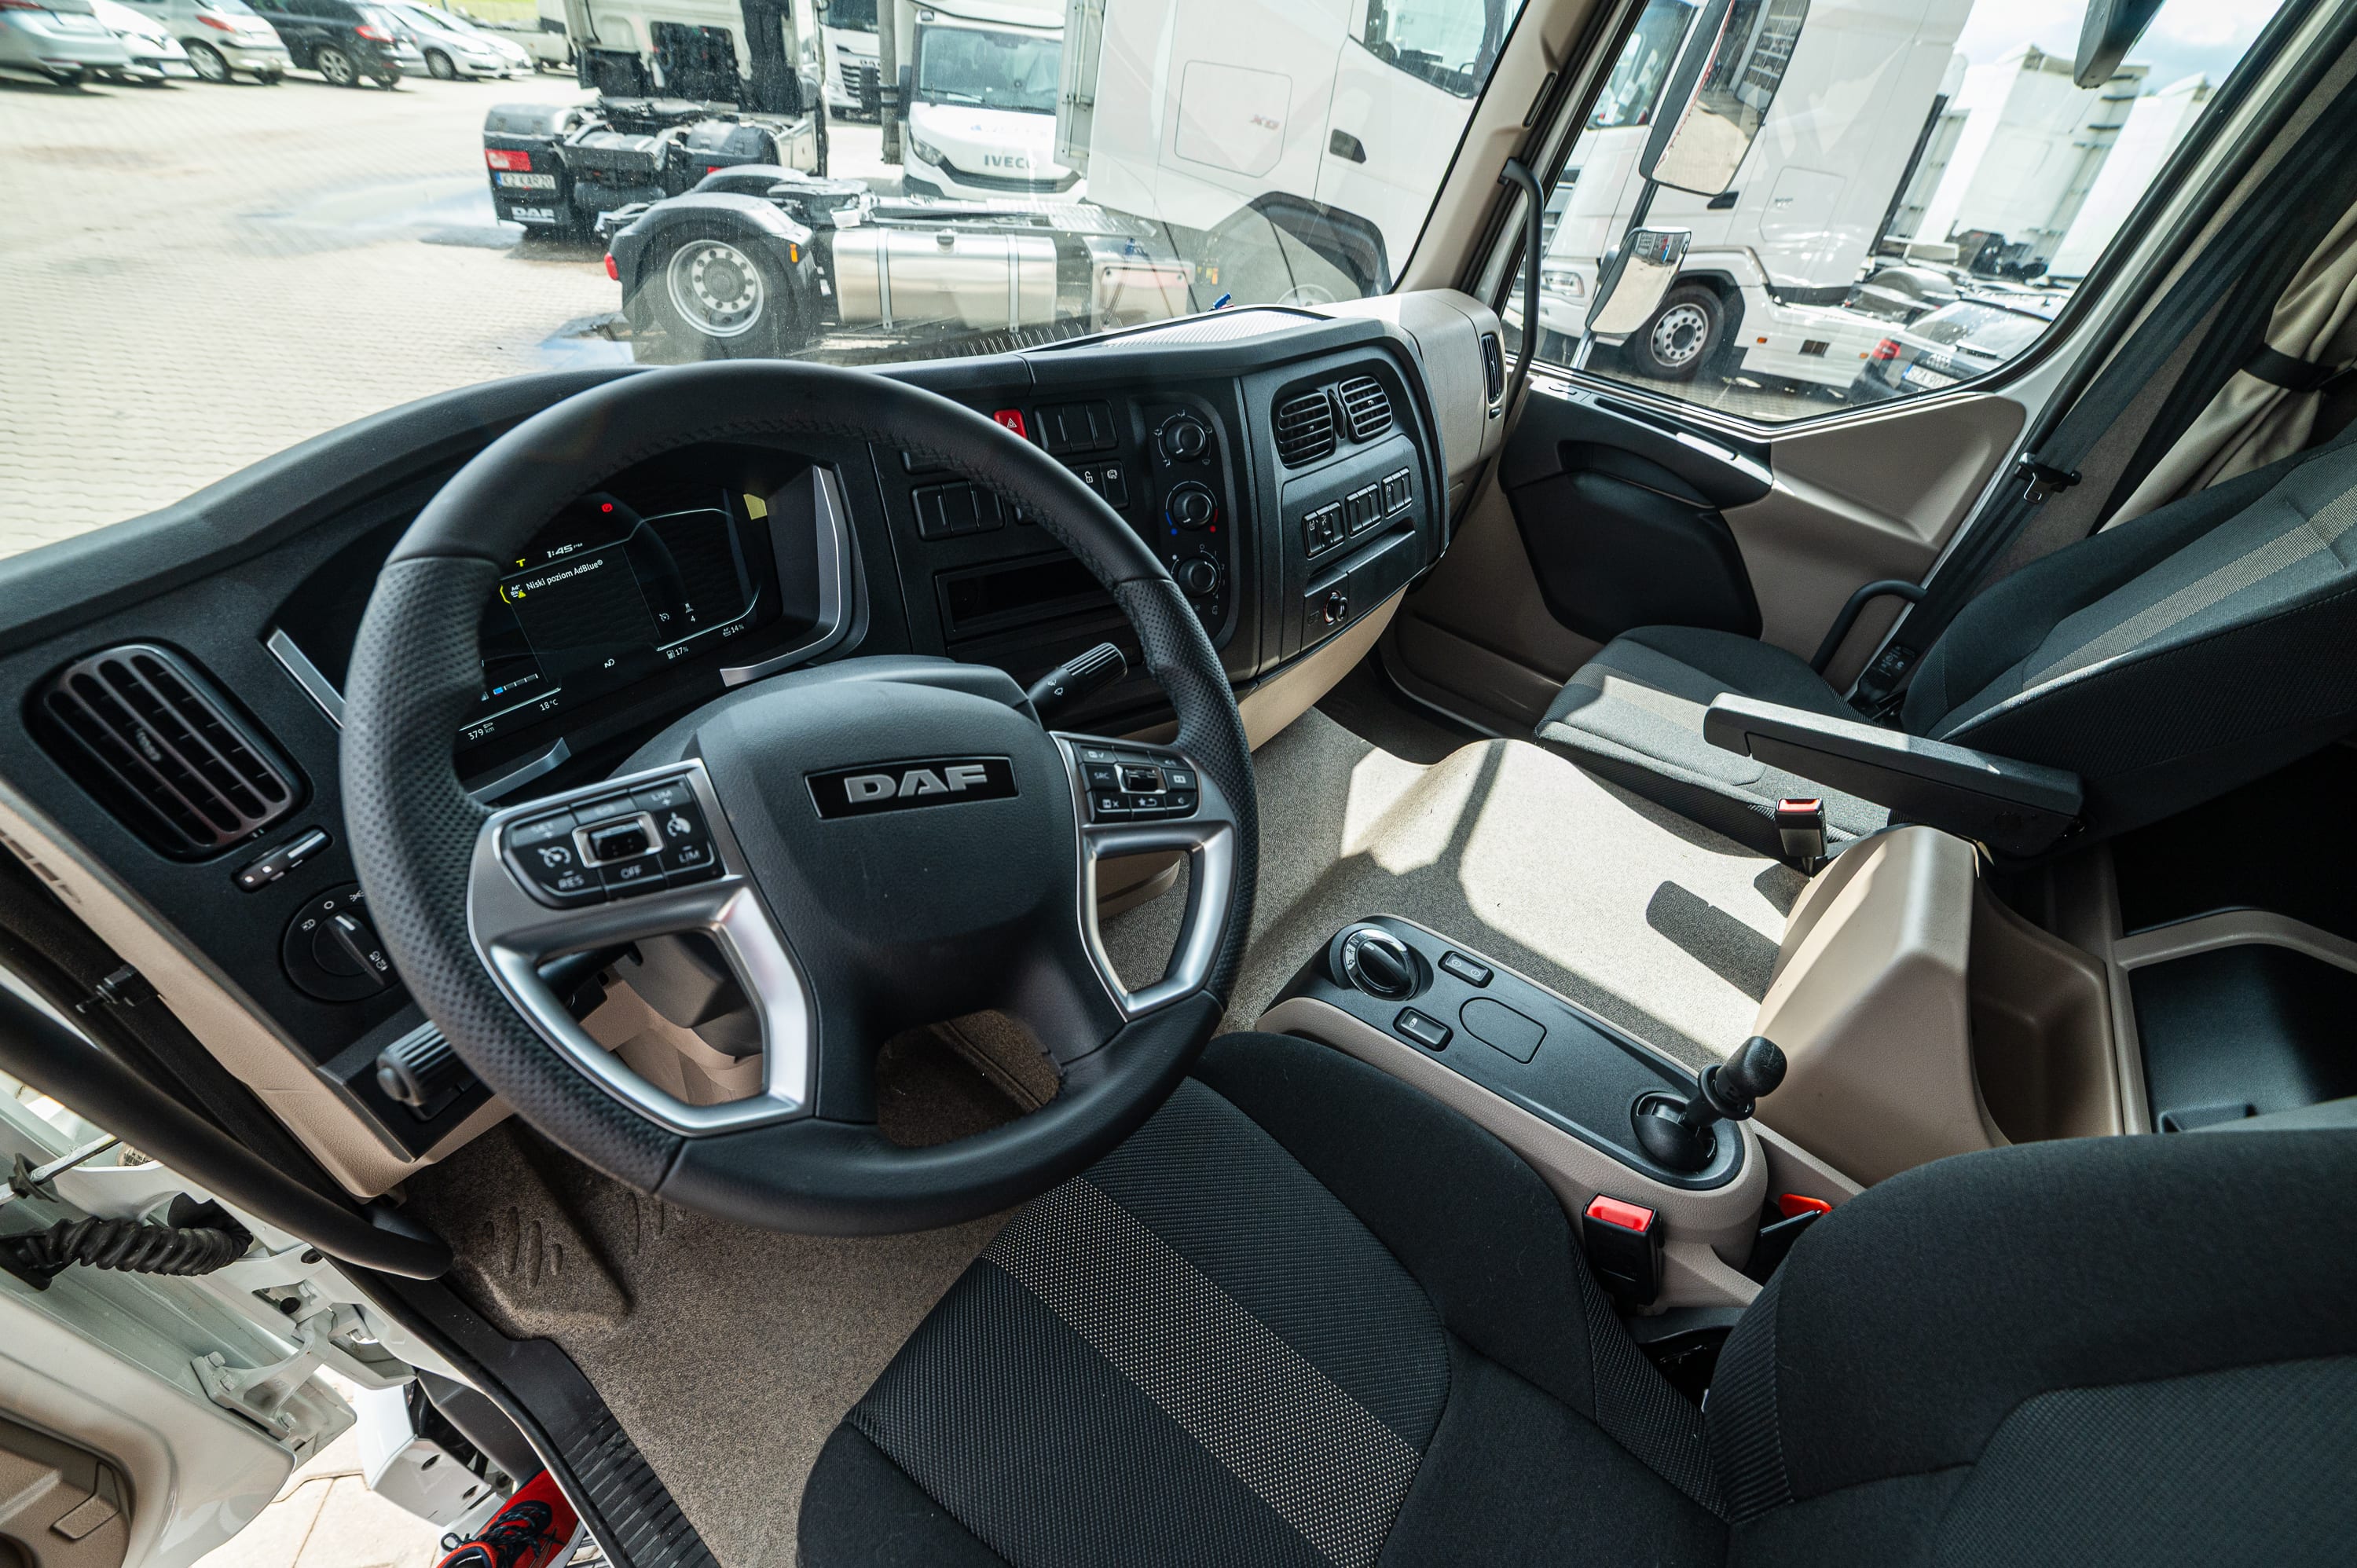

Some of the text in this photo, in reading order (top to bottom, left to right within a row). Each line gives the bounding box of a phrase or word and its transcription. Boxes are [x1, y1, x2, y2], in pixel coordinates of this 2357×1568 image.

[511, 207, 555, 218] DAF
[547, 544, 574, 559] 1:45
[526, 578, 546, 590] Niski
[546, 570, 574, 585] poziom
[467, 728, 484, 740] 379
[843, 764, 988, 804] DAF
[678, 850, 700, 863] LIM
[620, 865, 643, 879] OFF
[557, 874, 585, 890] RES
